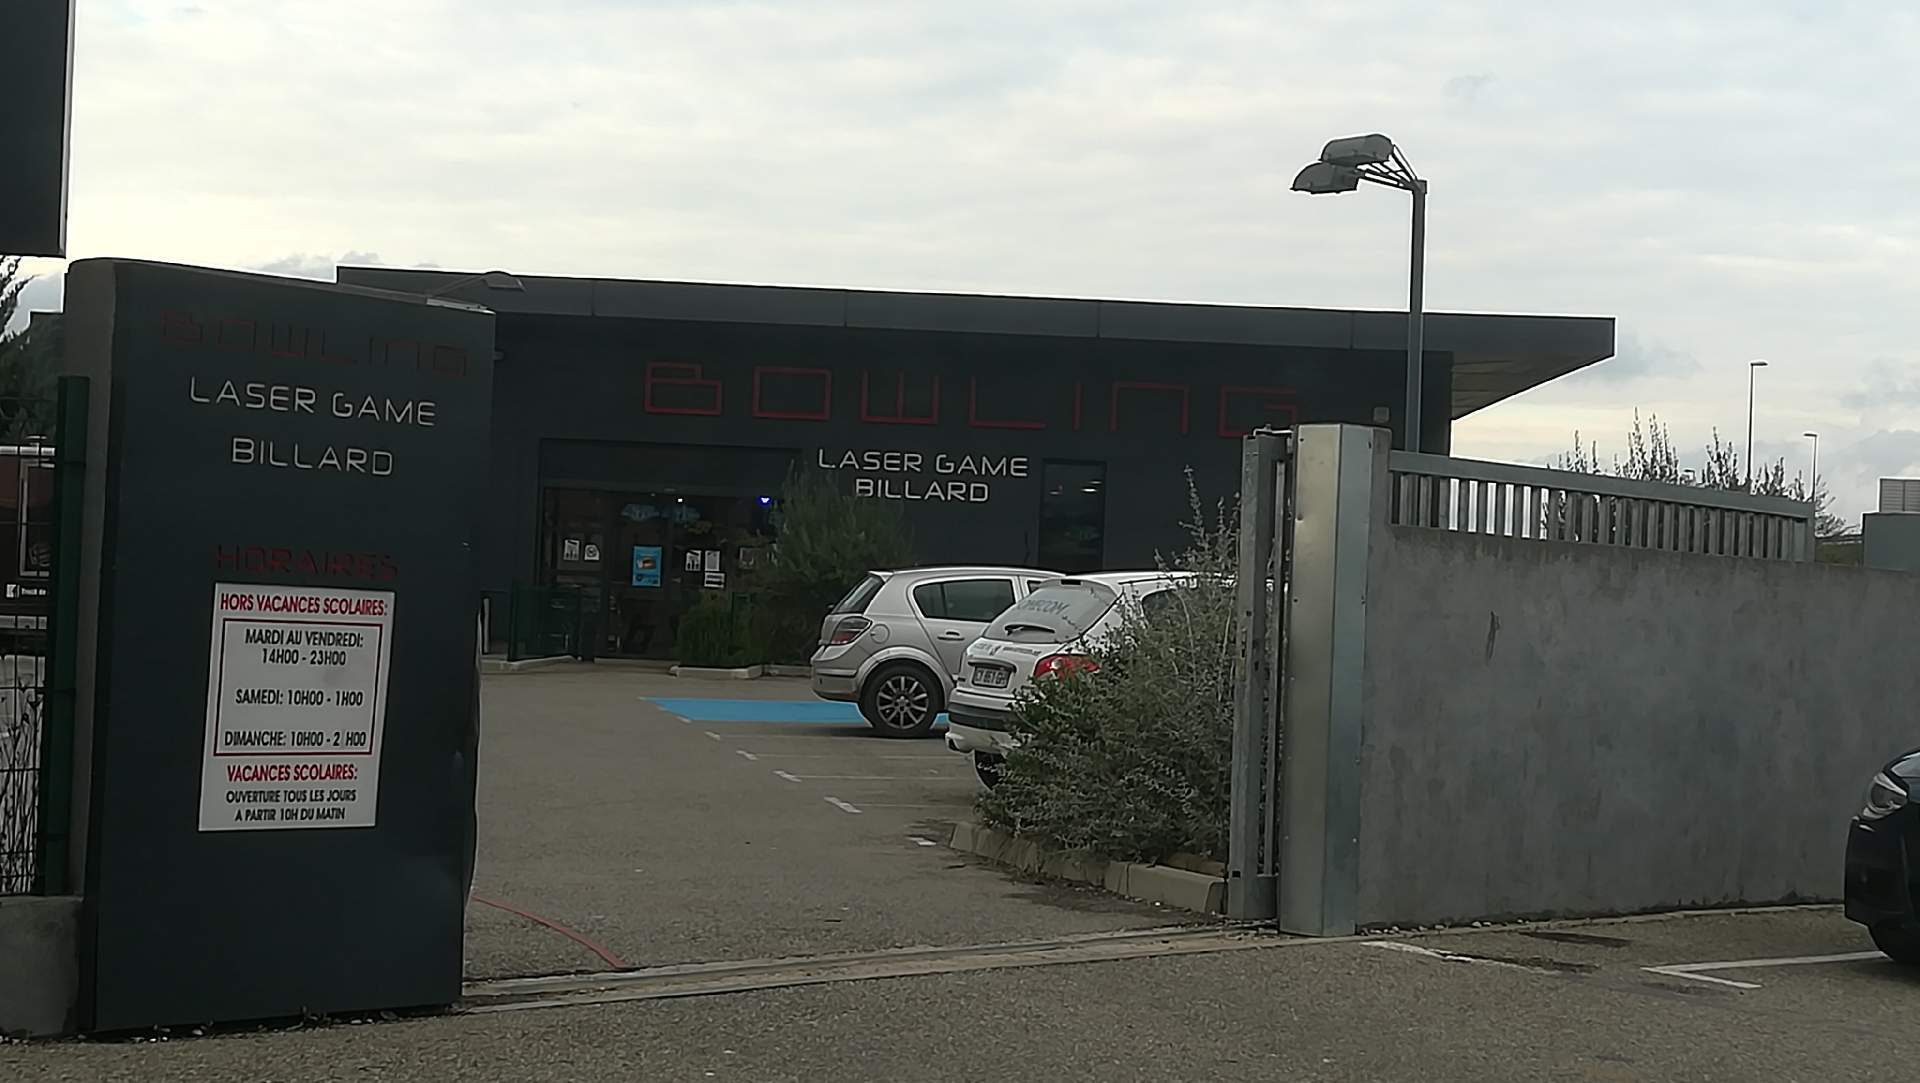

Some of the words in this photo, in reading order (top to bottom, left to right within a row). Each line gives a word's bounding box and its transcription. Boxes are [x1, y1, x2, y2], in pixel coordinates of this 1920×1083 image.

[190, 376, 316, 414] LASER
[332, 393, 436, 426] GAME
[644, 360, 1297, 438] BOWLING
[232, 437, 393, 476] BILLARD
[818, 448, 922, 472] LASER
[935, 453, 1028, 477] GAME
[855, 478, 989, 502] BILLARD
[217, 545, 399, 581] HORAIRES
[220, 592, 254, 610] HORS
[256, 594, 320, 614] VACANCES
[323, 598, 388, 616] SCOLAIRES:
[245, 629, 283, 644] MARDI
[287, 630, 302, 645] AU
[305, 631, 364, 647] VENDREDI:
[262, 649, 298, 664] 14H00
[310, 650, 346, 666] 23H00
[236, 689, 283, 704] SAMEDI:
[287, 690, 324, 705] 10H00
[336, 691, 363, 706] 1H00
[224, 732, 286, 746] DIMANCHE:
[291, 732, 324, 746] 10H00
[227, 765, 290, 782] VACANCES
[294, 764, 358, 780] SCOLAIRES:
[226, 790, 280, 803] OUVERTURE
[284, 790, 307, 802] TOUS
[310, 790, 324, 802] LES
[327, 790, 356, 802] JOURS
[235, 810, 242, 821] A
[245, 809, 276, 821] PARTIR
[280, 808, 298, 820] 10H
[300, 808, 314, 820] DU
[316, 808, 345, 820] MATIN
